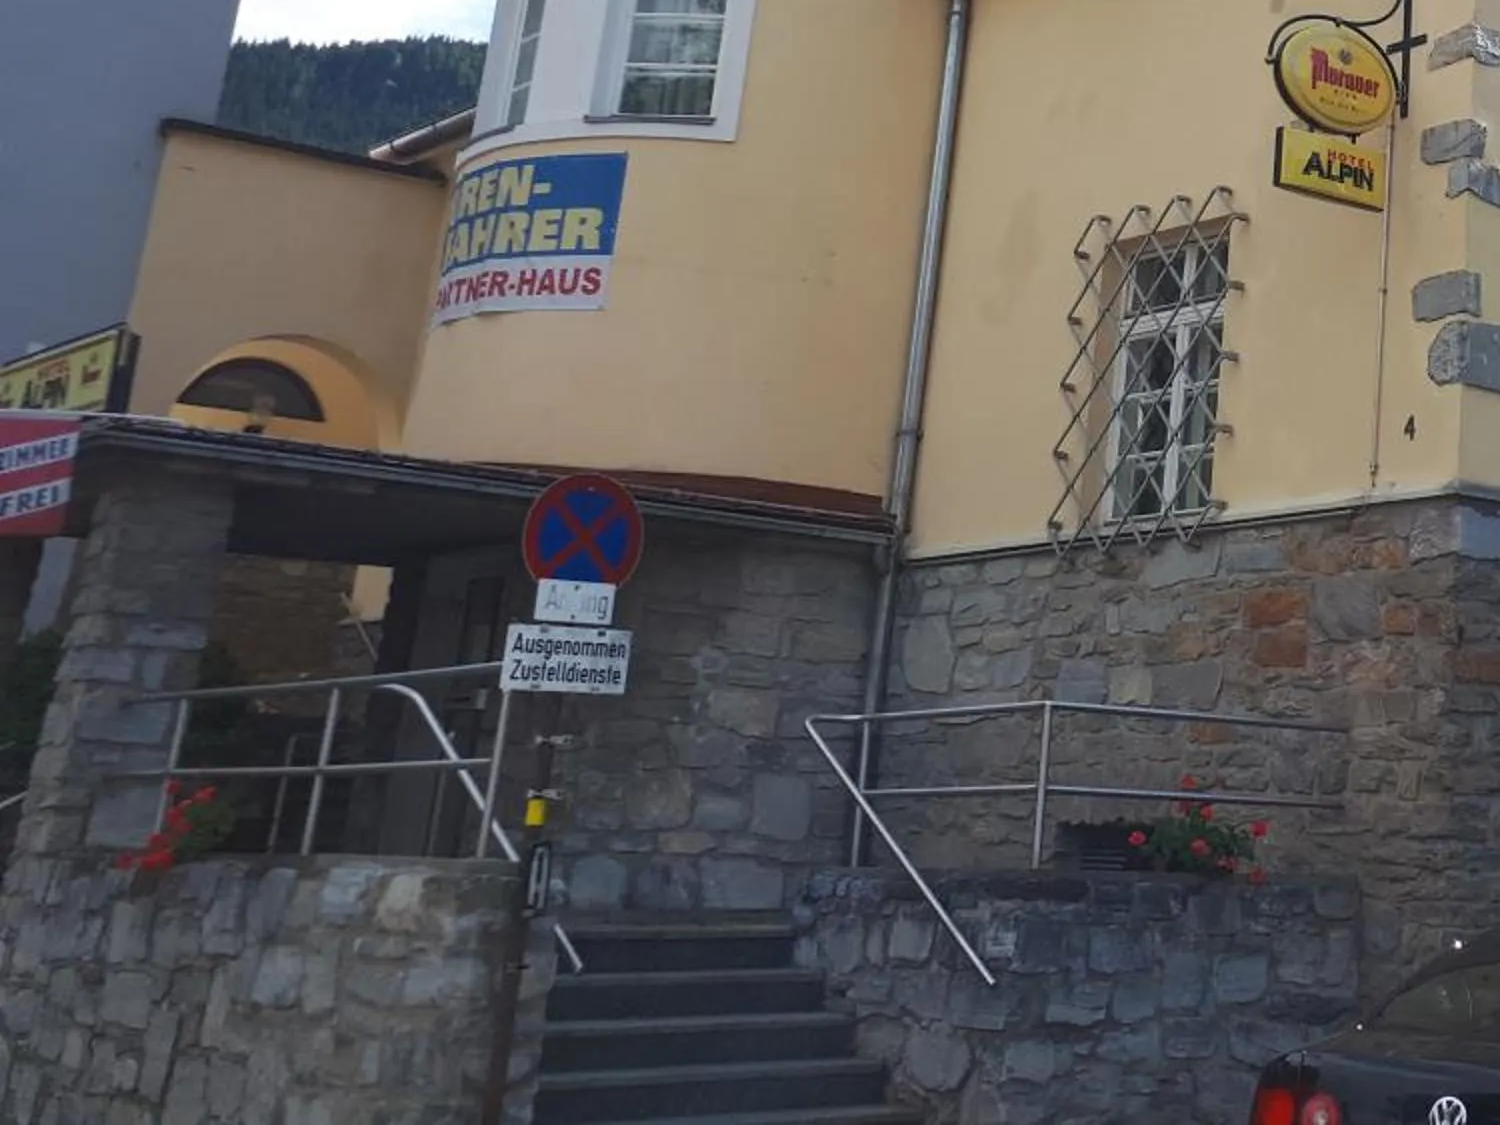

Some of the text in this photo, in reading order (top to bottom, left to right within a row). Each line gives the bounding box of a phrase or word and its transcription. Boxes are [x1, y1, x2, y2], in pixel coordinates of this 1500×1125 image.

[1302, 152, 1374, 192] ALPIN
[1328, 148, 1374, 171] HOTEL
[454, 165, 551, 218] REN-
[1404, 414, 1416, 441] 4
[0, 485, 58, 516] FREI
[543, 584, 609, 620] Ang
[512, 633, 626, 660] Ausgenommen
[509, 659, 621, 685] Zustelldienste
